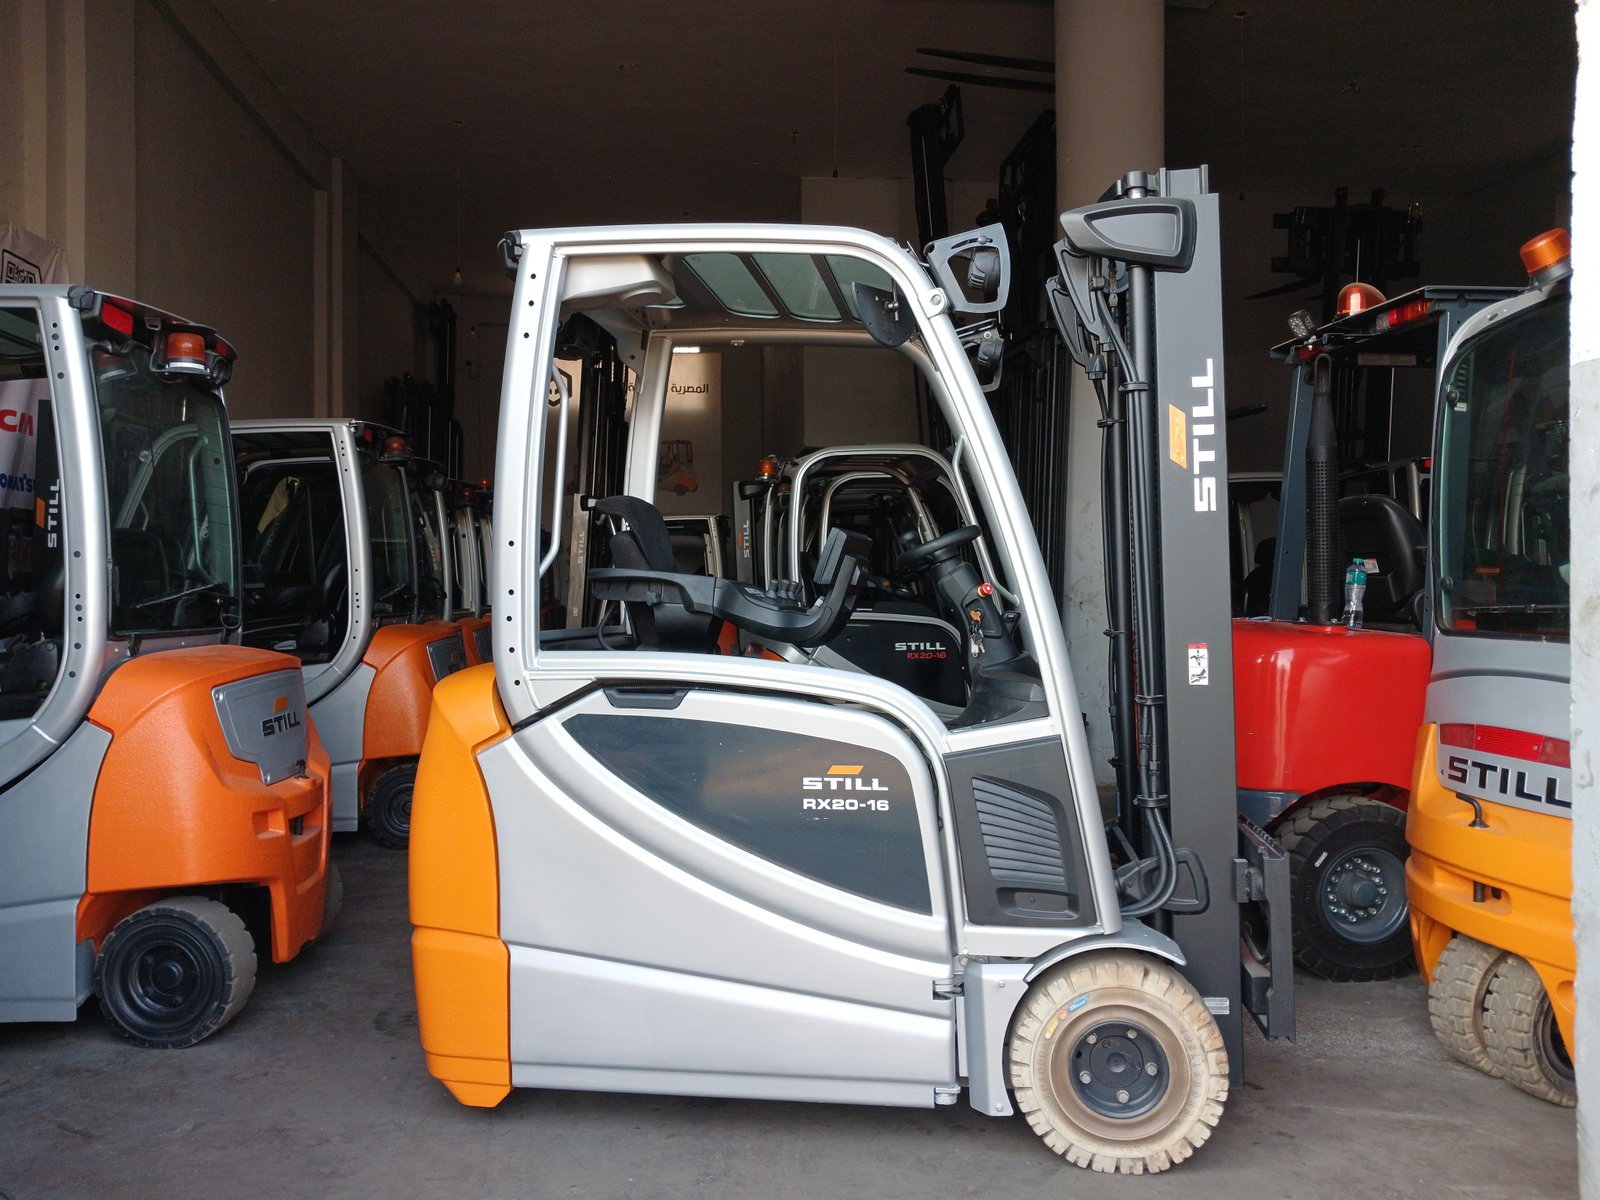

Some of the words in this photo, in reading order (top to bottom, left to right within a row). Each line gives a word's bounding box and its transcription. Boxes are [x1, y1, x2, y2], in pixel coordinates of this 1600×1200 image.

[671, 383, 709, 395] المصرية
[1191, 358, 1217, 512] STILL
[48, 478, 60, 548] STILL
[577, 530, 585, 565] STILL
[743, 520, 751, 560] STILL
[894, 642, 946, 651] STILL
[907, 652, 946, 660] RX20-16
[262, 711, 300, 737] STILL
[803, 777, 889, 791] STILL
[1448, 755, 1572, 809] STILL
[803, 798, 889, 811] RX20-16
